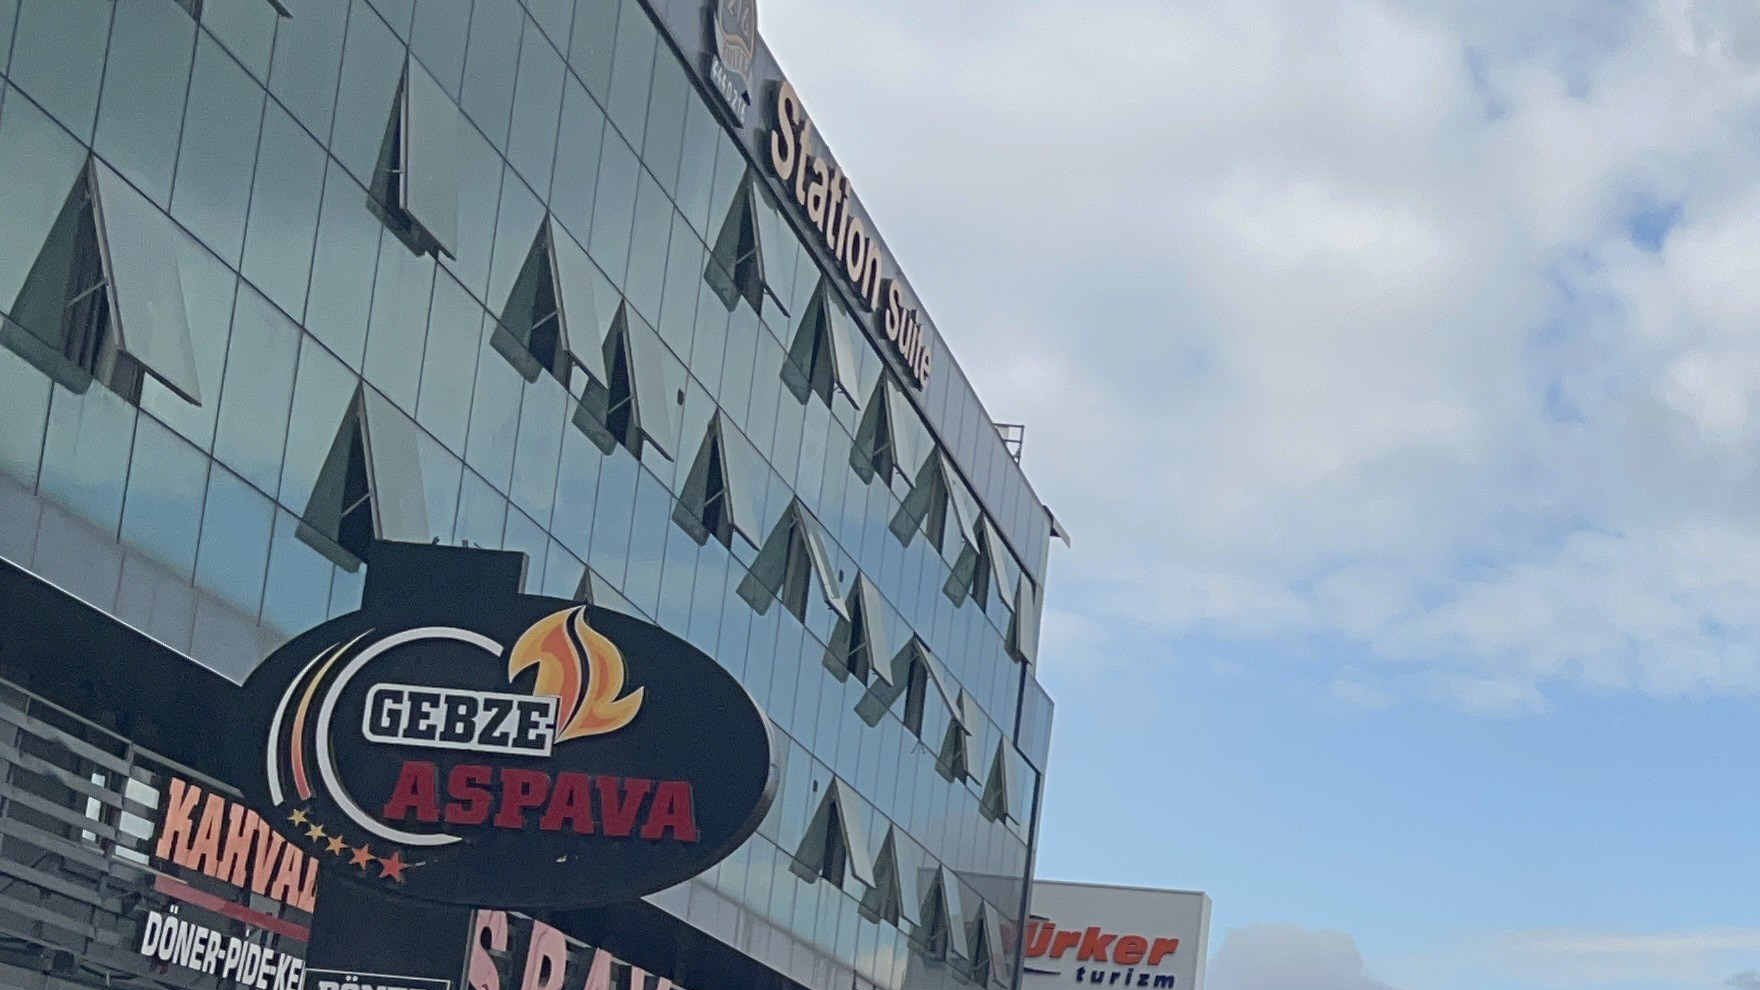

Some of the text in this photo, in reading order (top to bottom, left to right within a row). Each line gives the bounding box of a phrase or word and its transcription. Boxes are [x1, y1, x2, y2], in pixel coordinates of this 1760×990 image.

[771, 81, 932, 385] Station Suite
[368, 688, 556, 755] GEBZE
[382, 760, 698, 842] ASPAVA
[156, 777, 319, 913] KAHVAL
[1076, 966, 1176, 990] turizm
